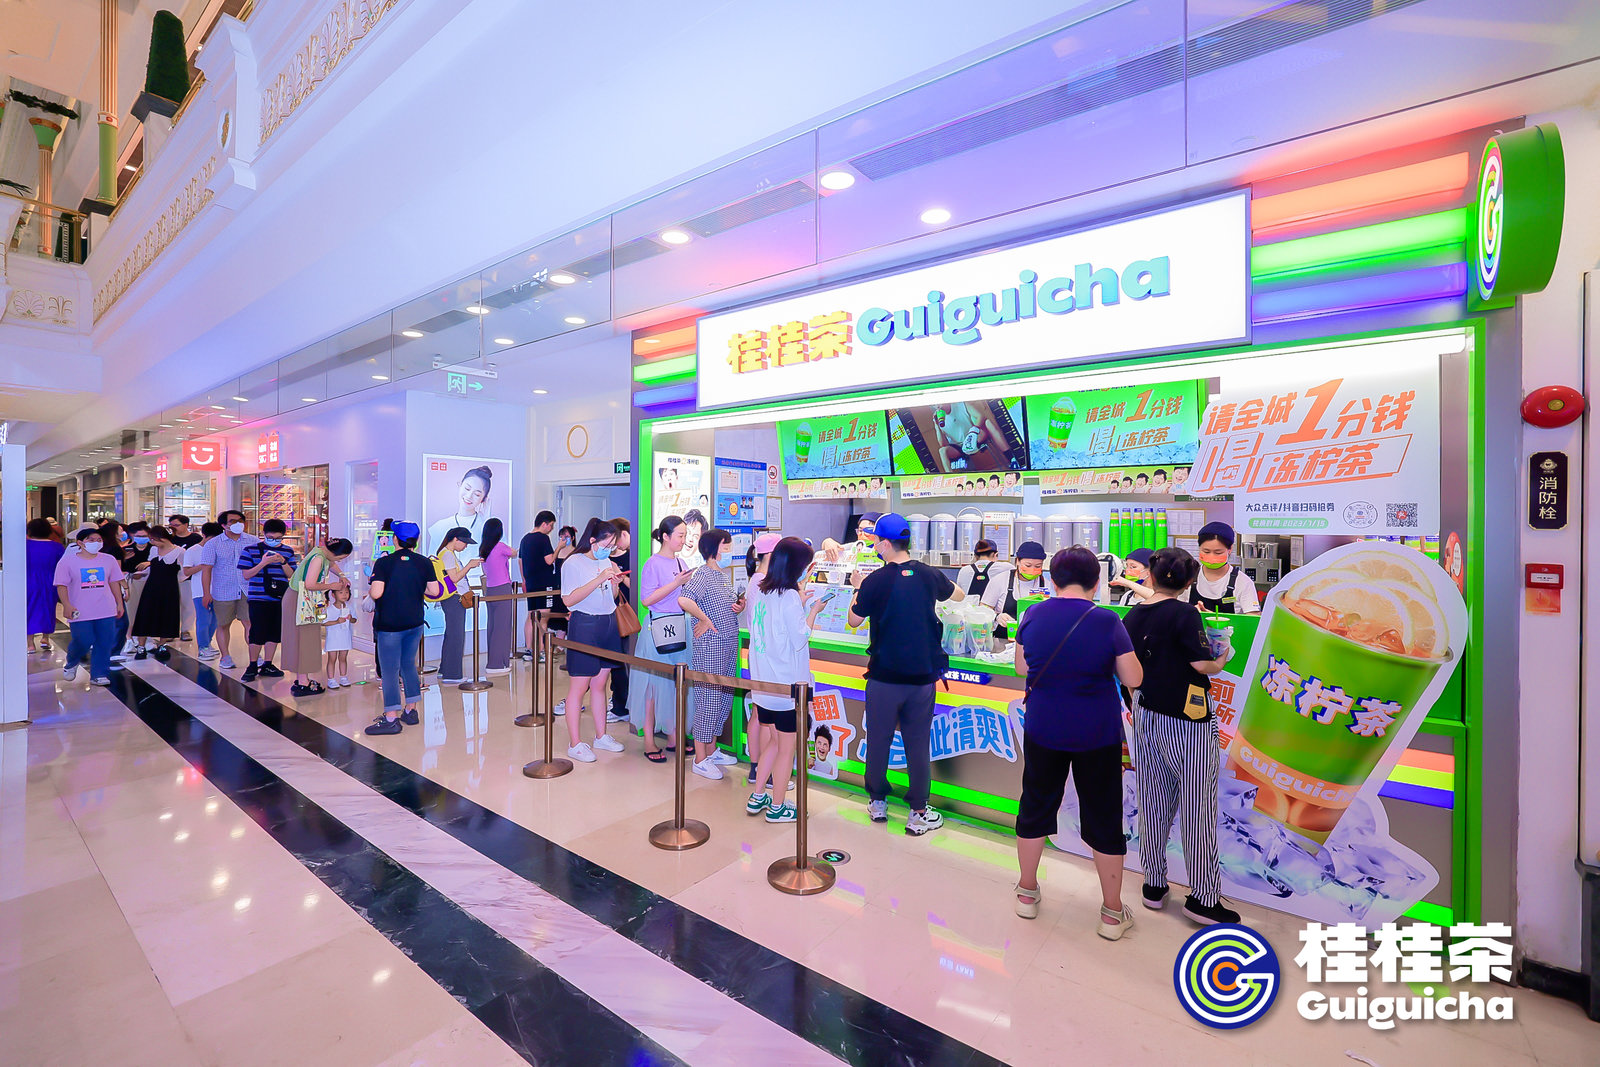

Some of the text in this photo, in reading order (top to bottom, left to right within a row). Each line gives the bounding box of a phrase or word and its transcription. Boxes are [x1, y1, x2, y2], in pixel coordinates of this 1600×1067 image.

[727, 255, 1171, 375] 桂桂茶 Guiguicha
[1085, 389, 1183, 423] 请全城1分钱
[1205, 378, 1415, 445] 请全城1分钱
[1538, 476, 1557, 520] 消防栓
[663, 624, 676, 638] NY
[960, 673, 980, 682] TAKE
[1260, 654, 1402, 737] 冻柠茶
